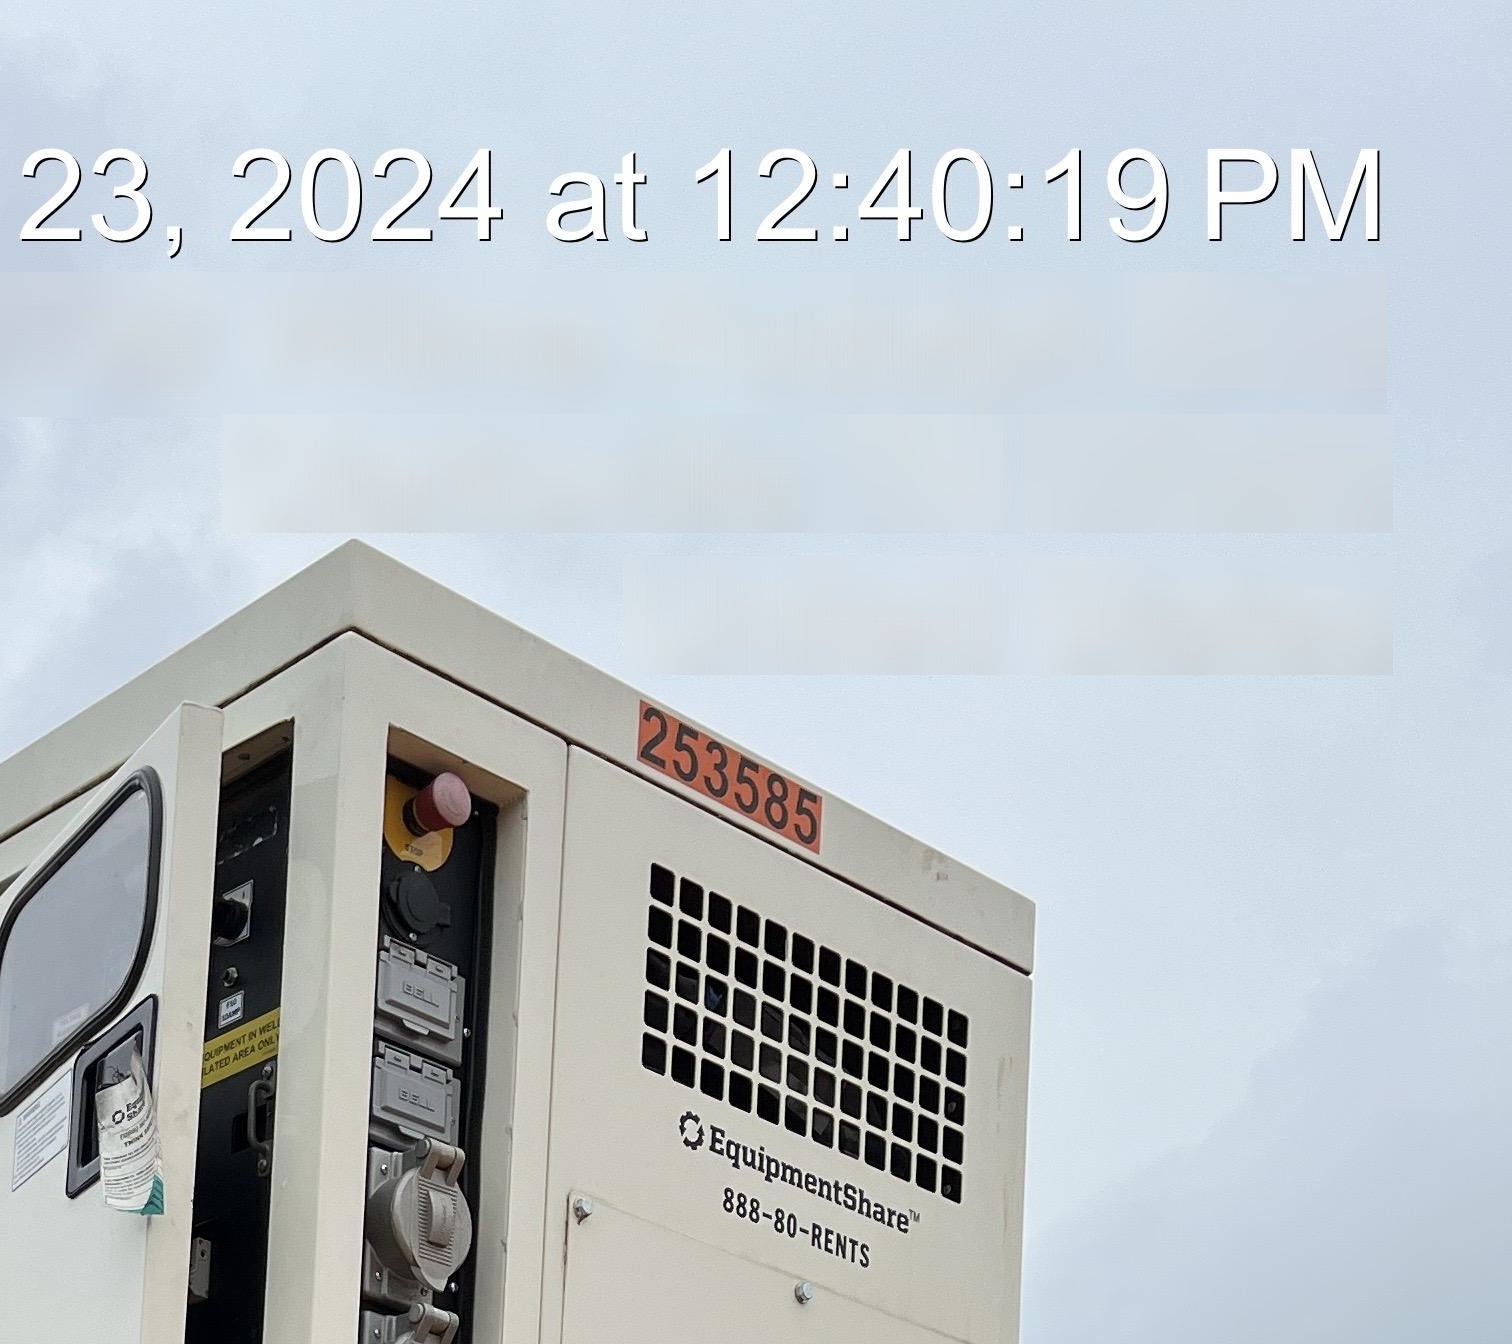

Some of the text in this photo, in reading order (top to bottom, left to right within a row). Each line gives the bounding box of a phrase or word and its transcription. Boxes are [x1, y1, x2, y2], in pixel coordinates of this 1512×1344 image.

[640, 707, 818, 844] 253585
[203, 1034, 247, 1061] QUIPMENT
[723, 1187, 870, 1268] 888-80-RENTS
